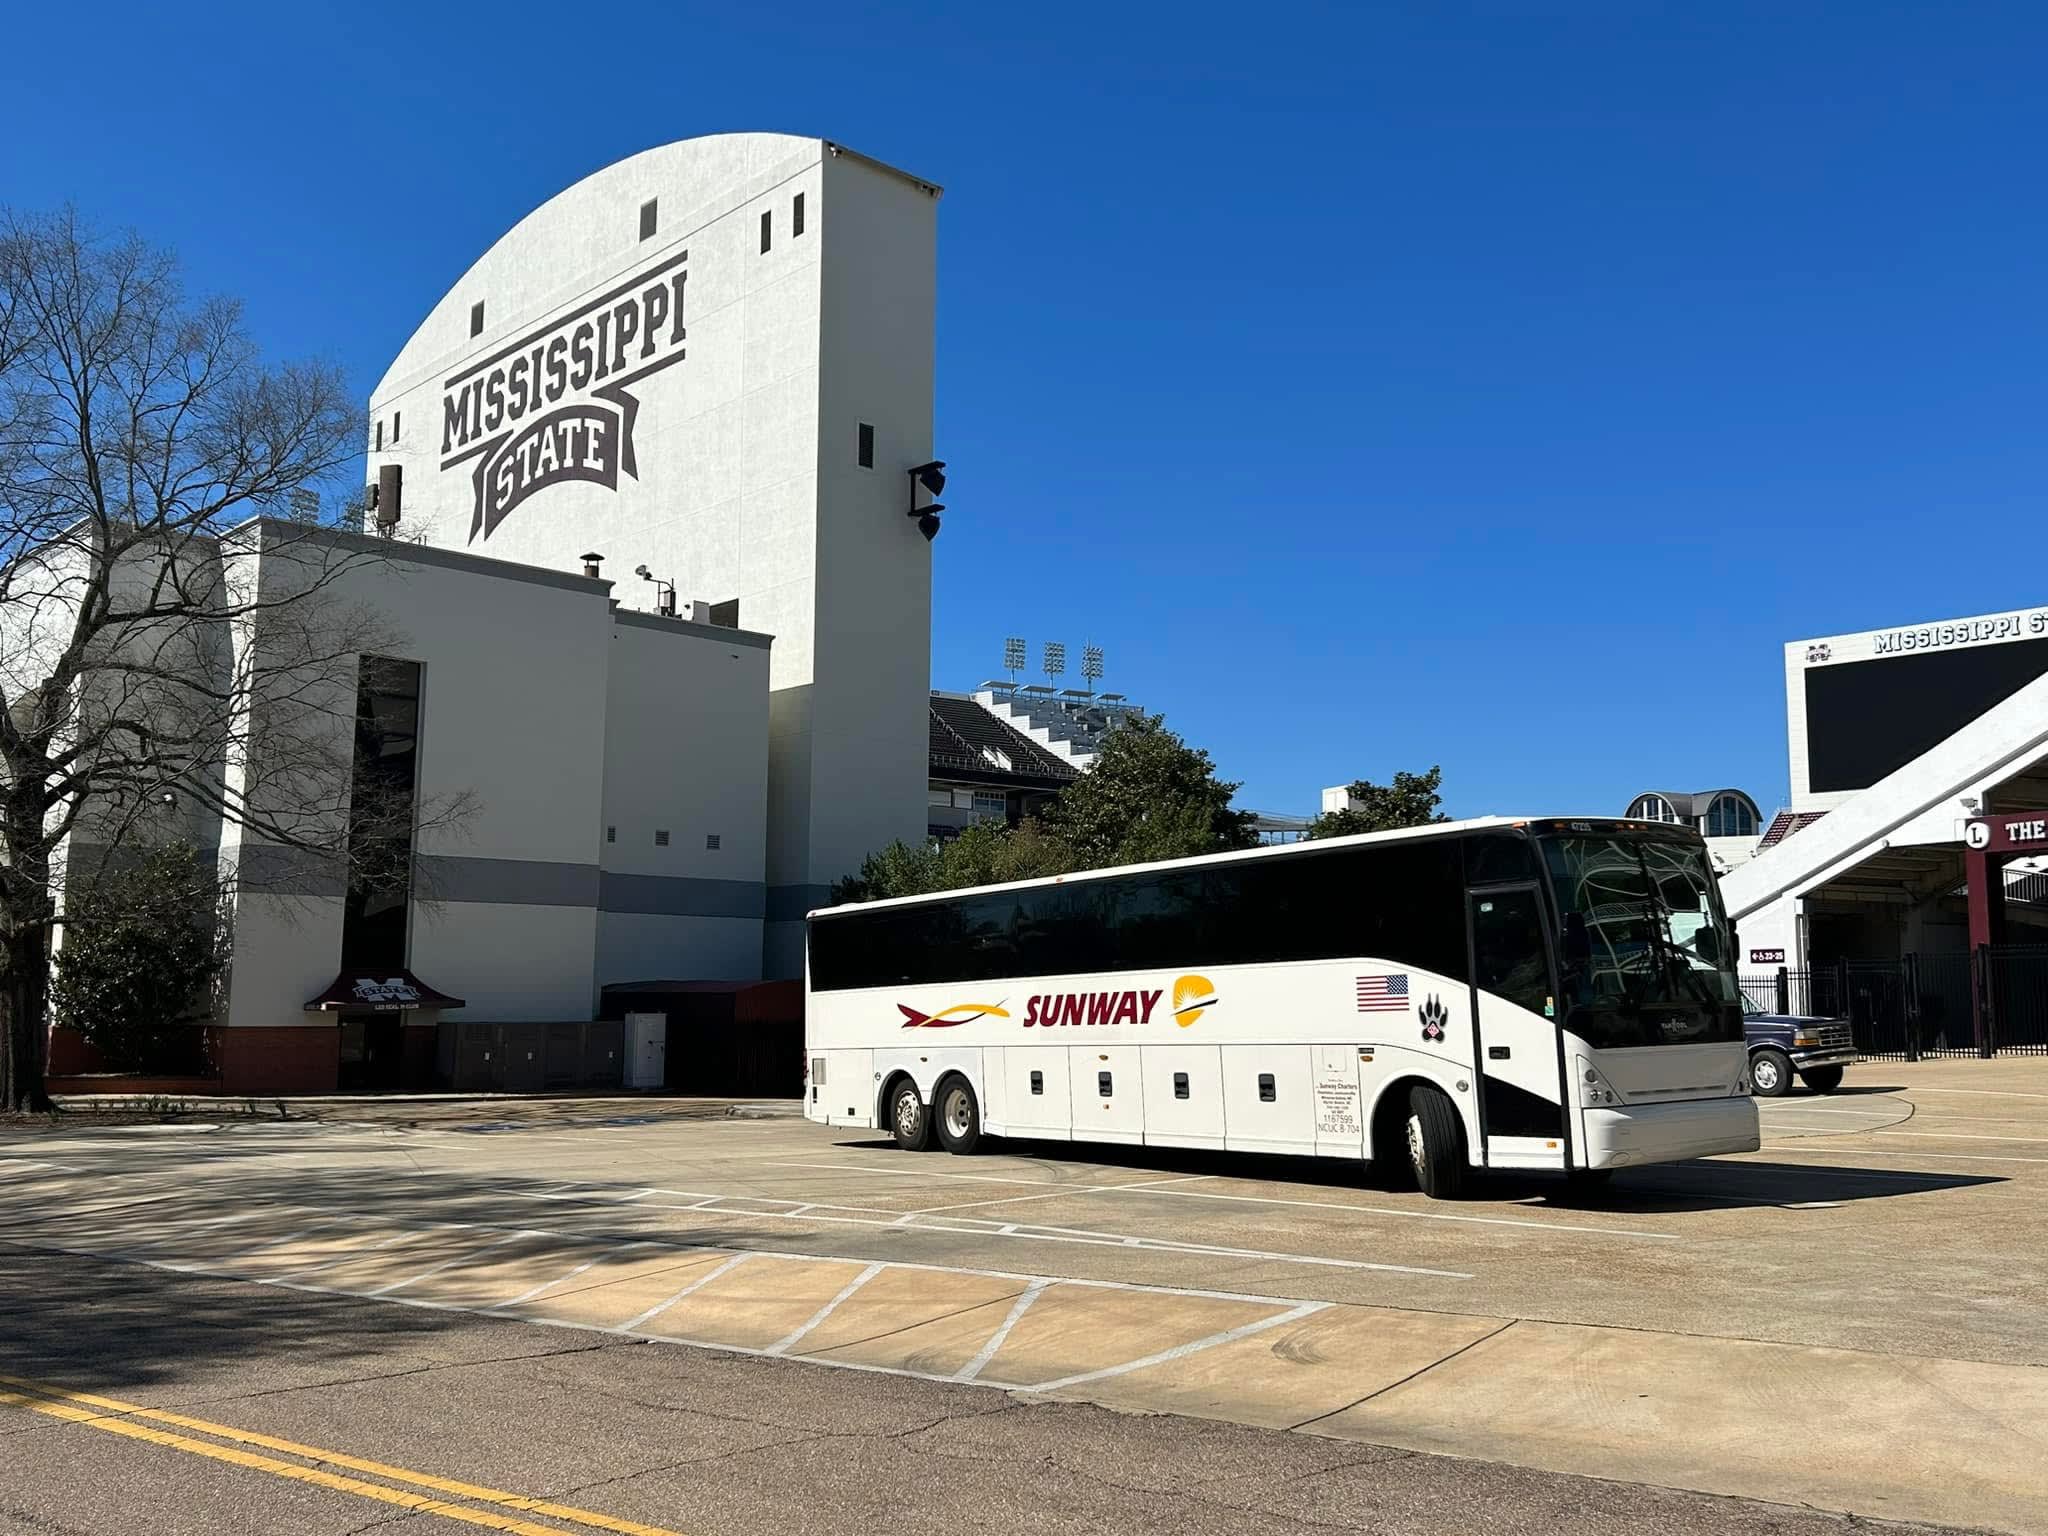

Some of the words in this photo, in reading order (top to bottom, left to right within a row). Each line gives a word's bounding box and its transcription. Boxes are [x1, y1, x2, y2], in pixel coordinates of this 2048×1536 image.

[441, 269, 687, 455] MISSISSIPPI
[496, 417, 605, 511] STATE
[1873, 615, 2021, 654] MISSISSIPPI
[1971, 827, 1983, 844] L
[2004, 820, 2046, 841] THE
[1023, 989, 1164, 1027] SUNWAY
